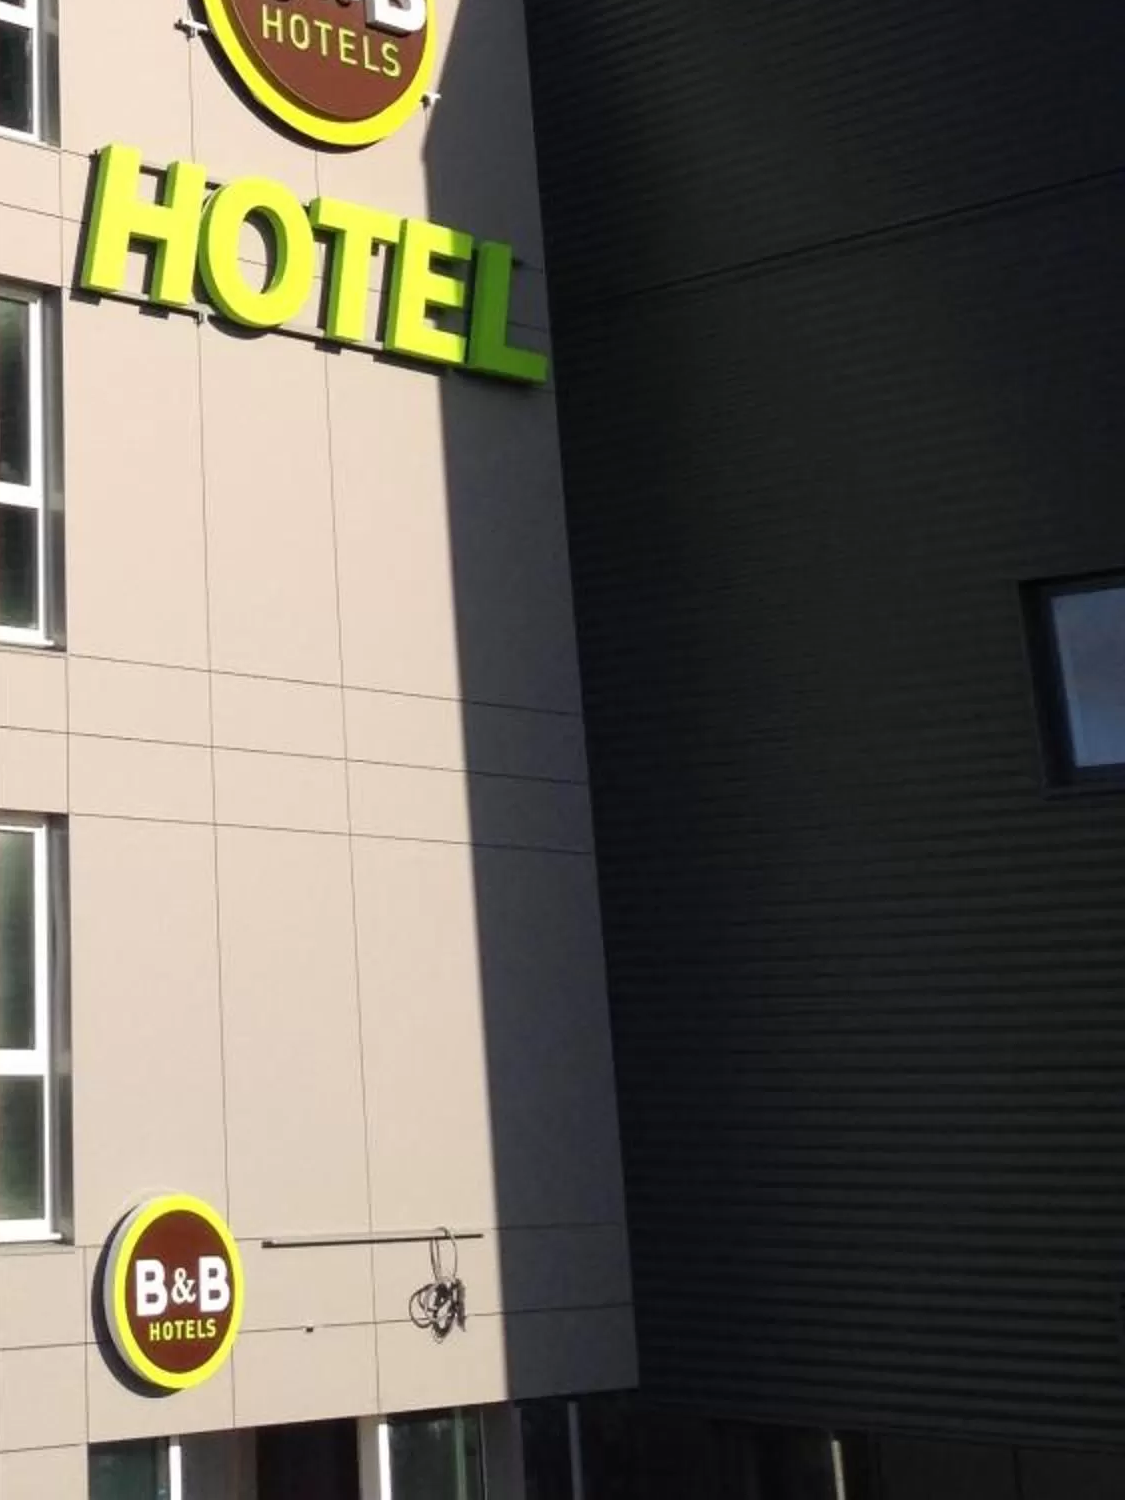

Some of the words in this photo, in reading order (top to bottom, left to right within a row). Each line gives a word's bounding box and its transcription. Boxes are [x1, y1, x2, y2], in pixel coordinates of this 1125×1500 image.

[261, 3, 402, 78] HOTELS
[81, 143, 548, 384] HOTEL
[135, 1255, 230, 1317] B&B
[149, 1318, 217, 1341] HOTELS
